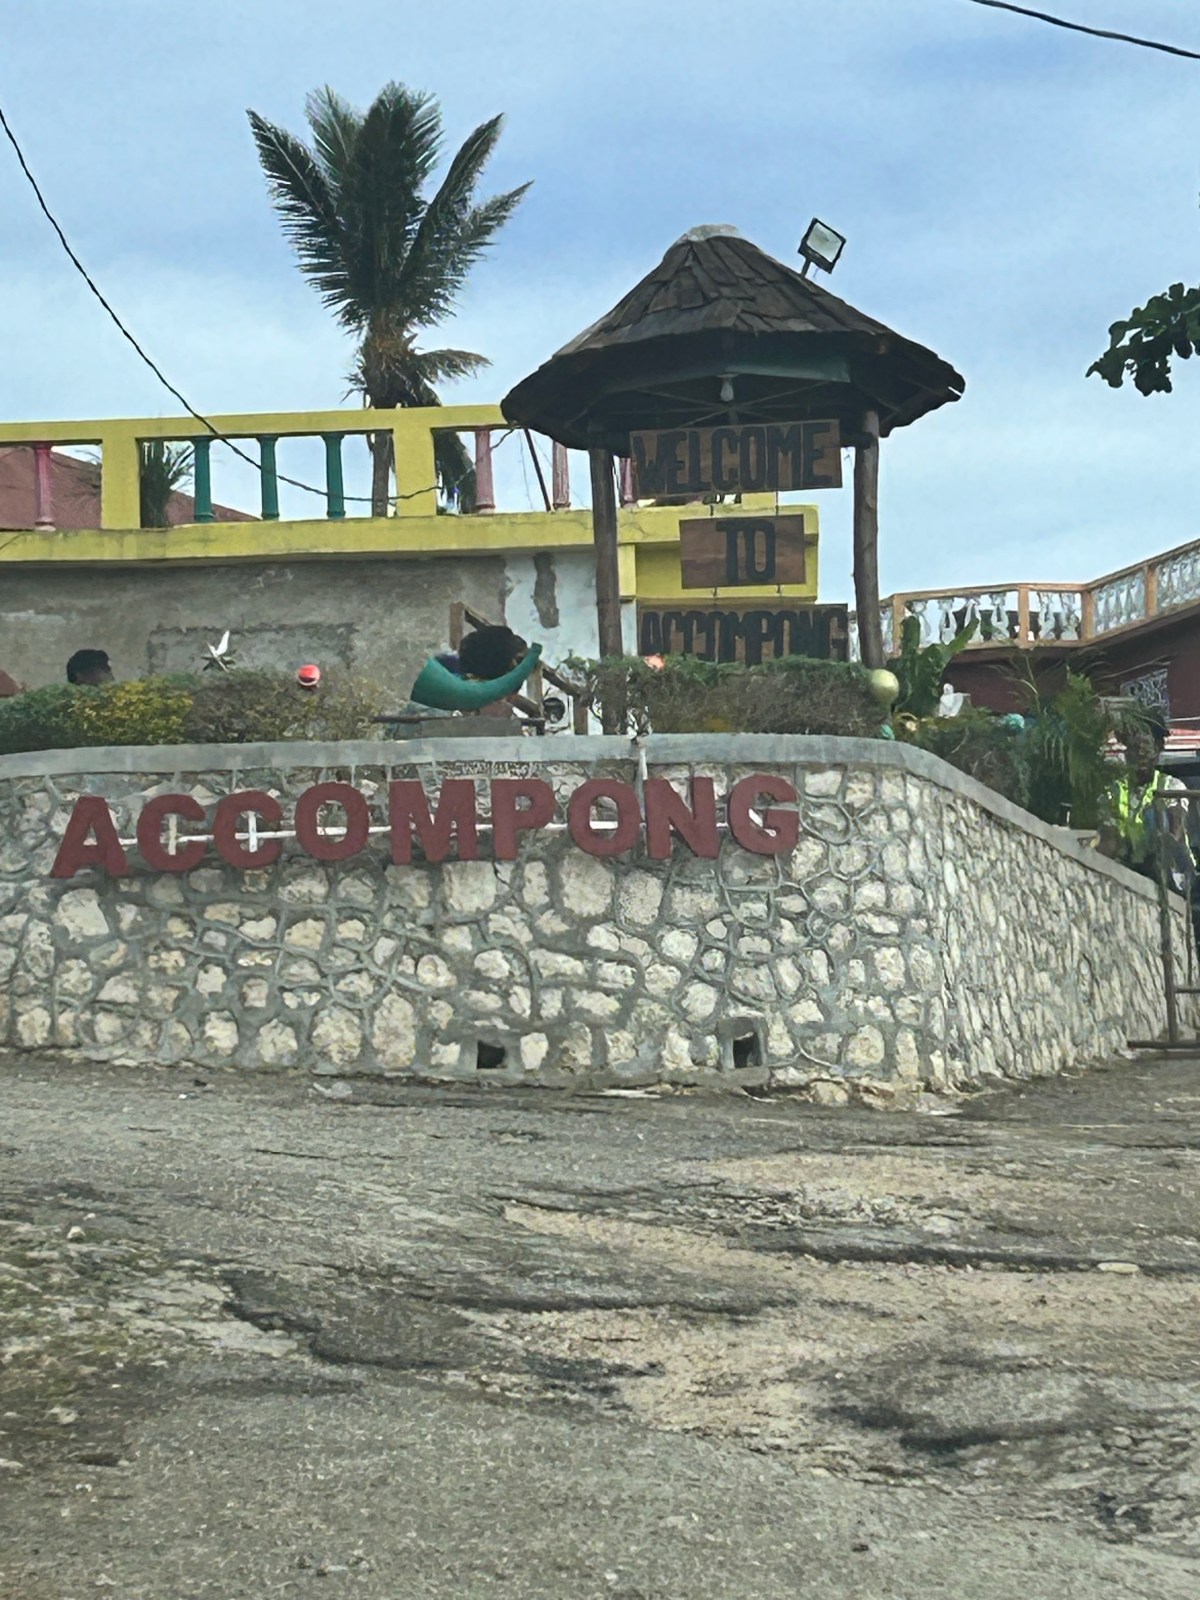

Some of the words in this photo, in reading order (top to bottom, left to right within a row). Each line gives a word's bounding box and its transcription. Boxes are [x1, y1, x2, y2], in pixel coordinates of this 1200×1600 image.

[633, 422, 832, 493] WELCOME
[715, 519, 776, 583] TO
[641, 608, 848, 666] ACCOMPONG
[51, 774, 800, 878] ACCOMPONG
